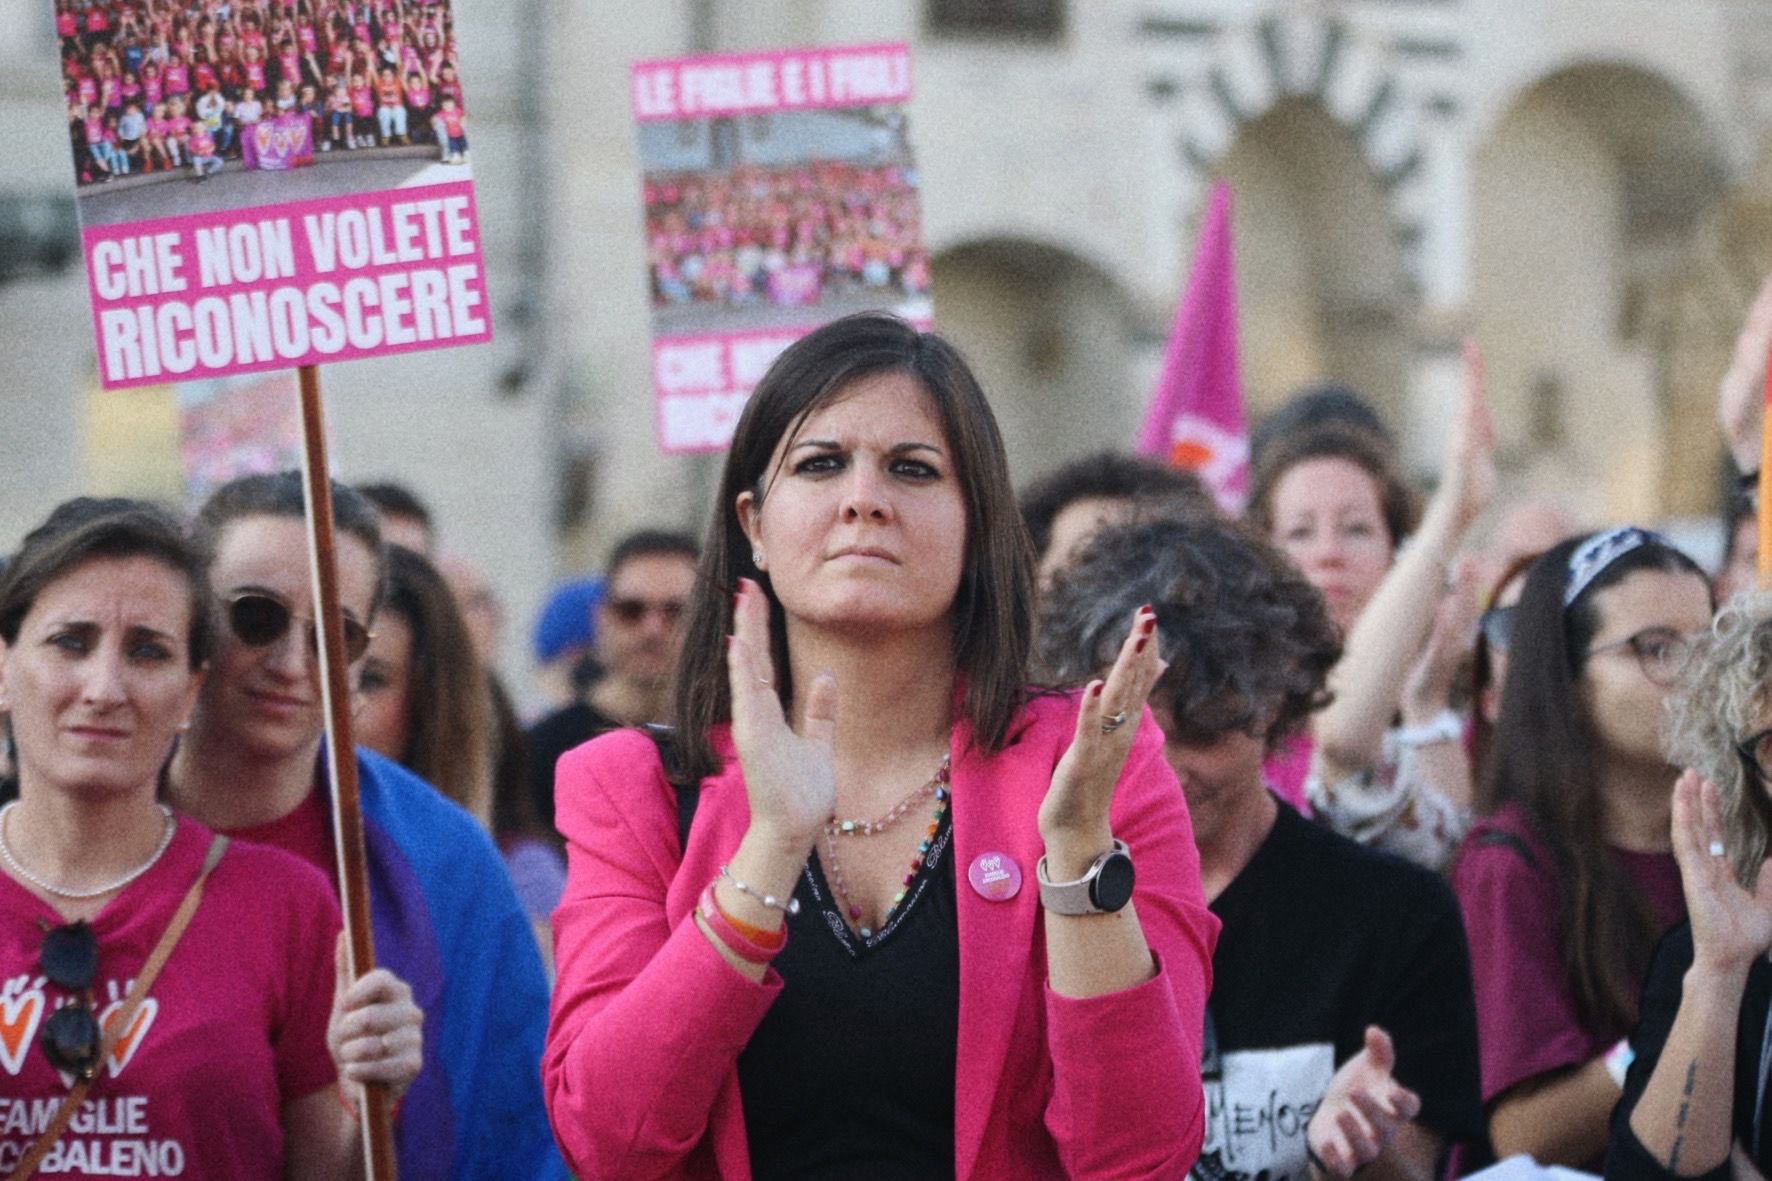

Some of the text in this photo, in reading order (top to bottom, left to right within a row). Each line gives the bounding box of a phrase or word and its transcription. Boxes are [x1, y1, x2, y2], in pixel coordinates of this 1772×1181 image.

[637, 70, 674, 115] LE
[92, 196, 475, 301] CHE NON VOLETE
[100, 264, 486, 382] RICONOSCERE
